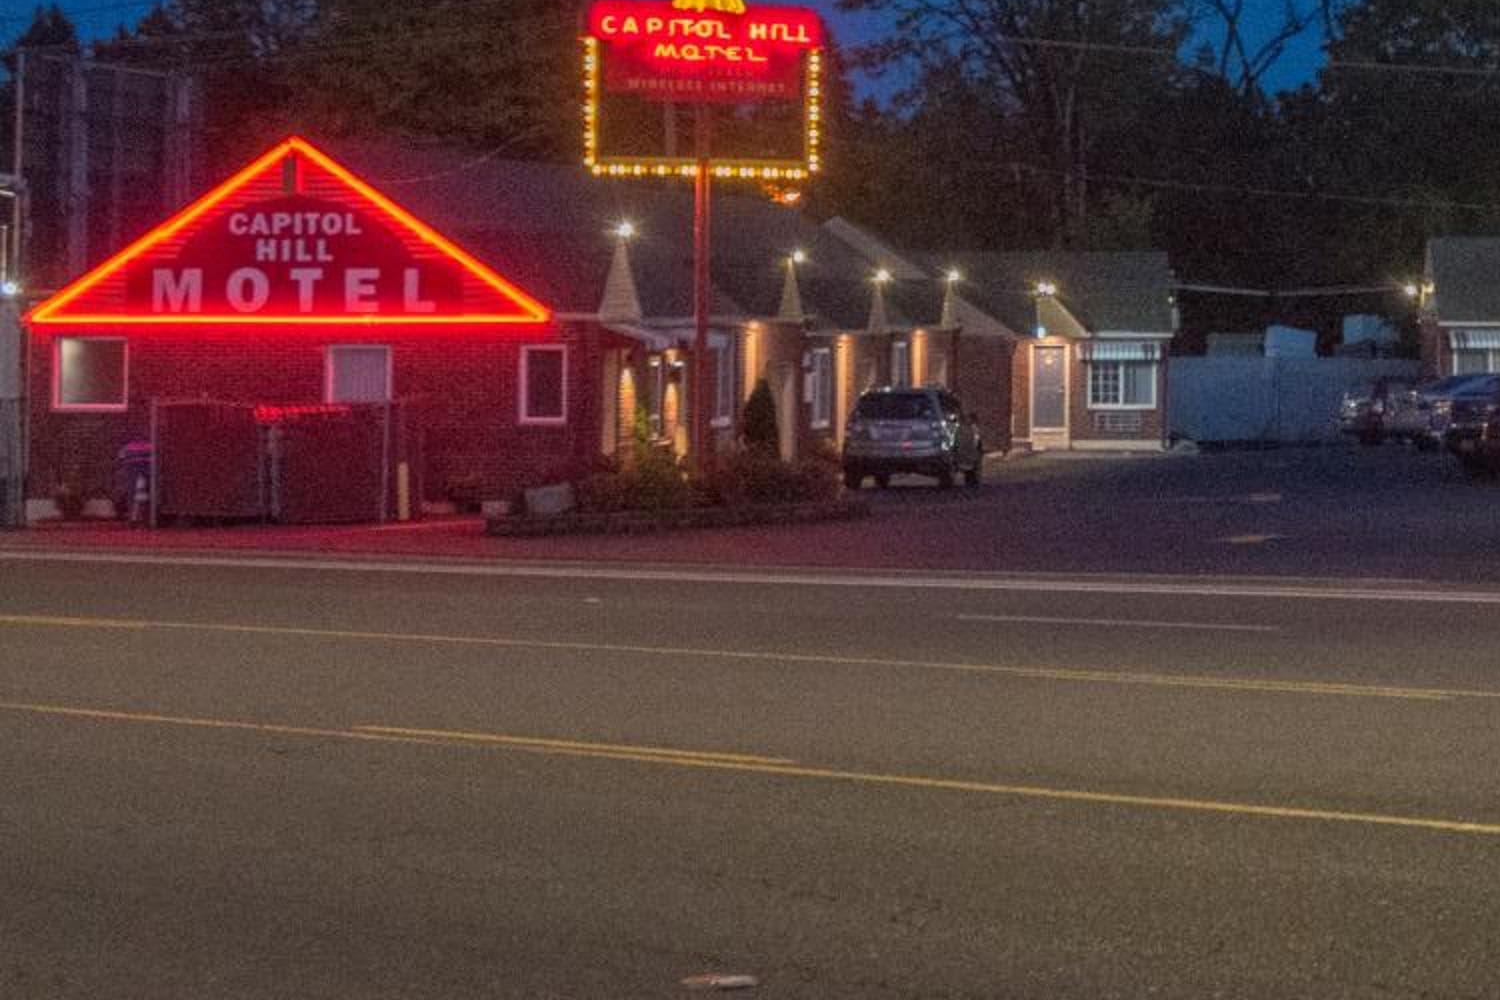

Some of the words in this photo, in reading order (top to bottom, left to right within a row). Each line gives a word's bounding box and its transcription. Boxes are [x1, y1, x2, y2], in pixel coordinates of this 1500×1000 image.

[601, 15, 731, 39] CAPITOL
[749, 23, 811, 43] HILL
[654, 43, 768, 62] MOTEL
[228, 211, 362, 237] CAPITOL
[255, 238, 334, 263] HILL
[151, 268, 436, 313] MOTEL
